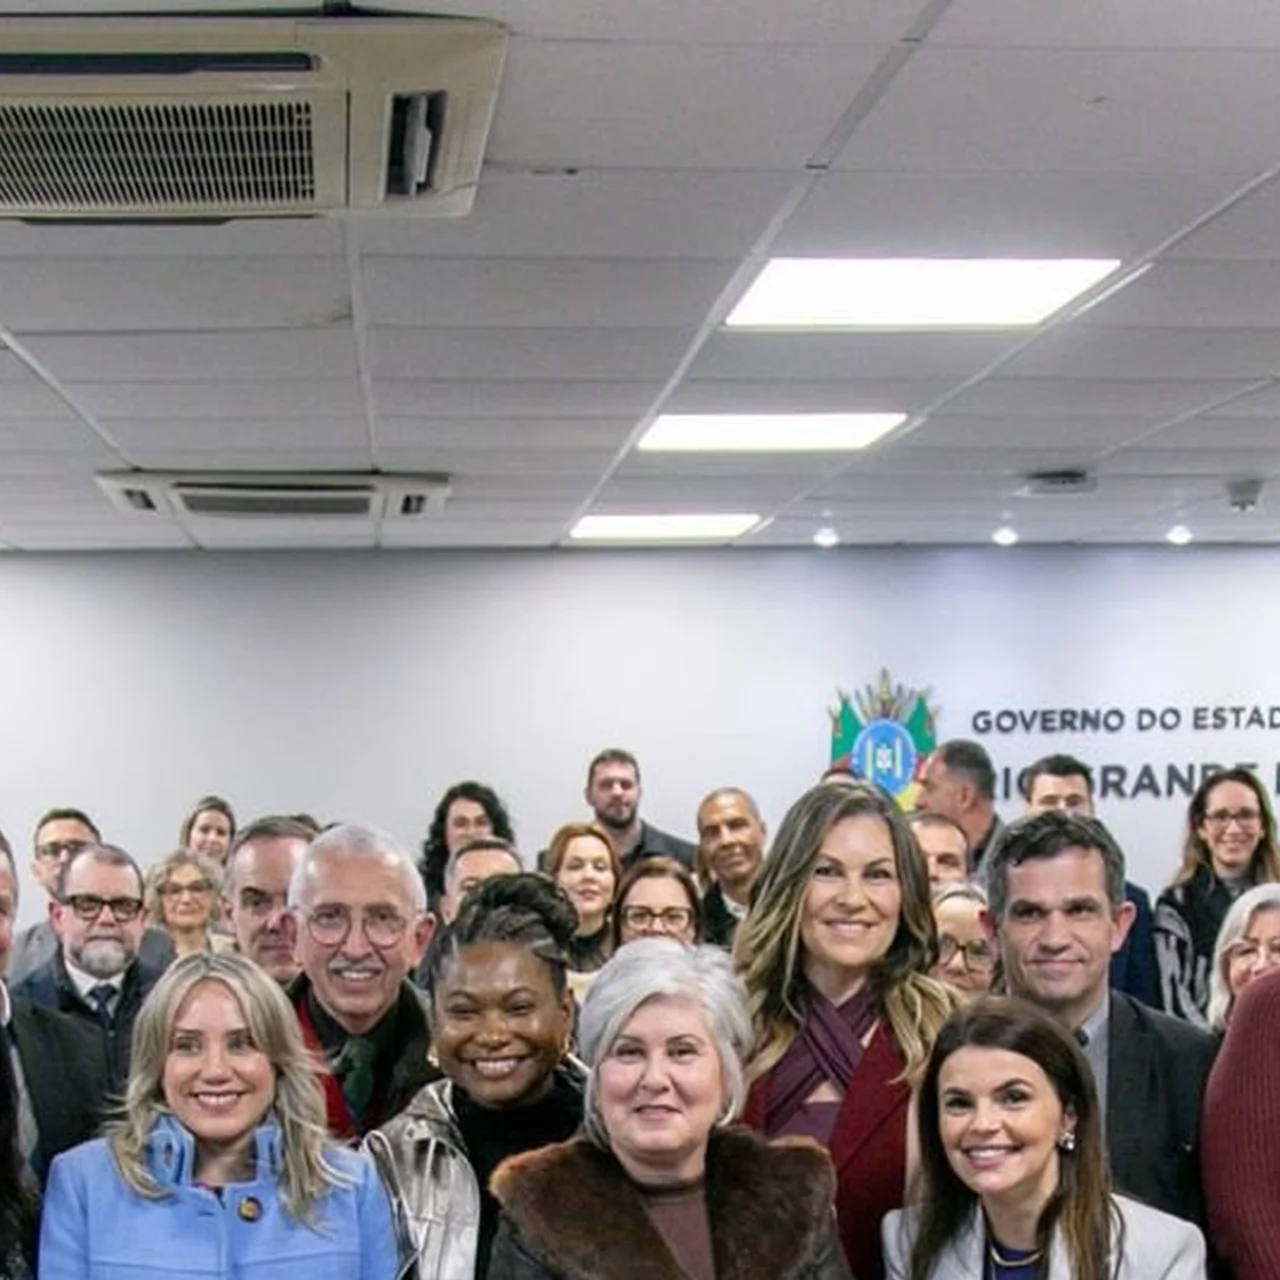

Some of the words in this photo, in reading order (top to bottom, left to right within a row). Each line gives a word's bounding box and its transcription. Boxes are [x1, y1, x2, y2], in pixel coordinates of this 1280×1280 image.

[972, 709, 1125, 733] GOVERNO
[1137, 707, 1181, 731] DO
[1099, 762, 1259, 799] RAN
